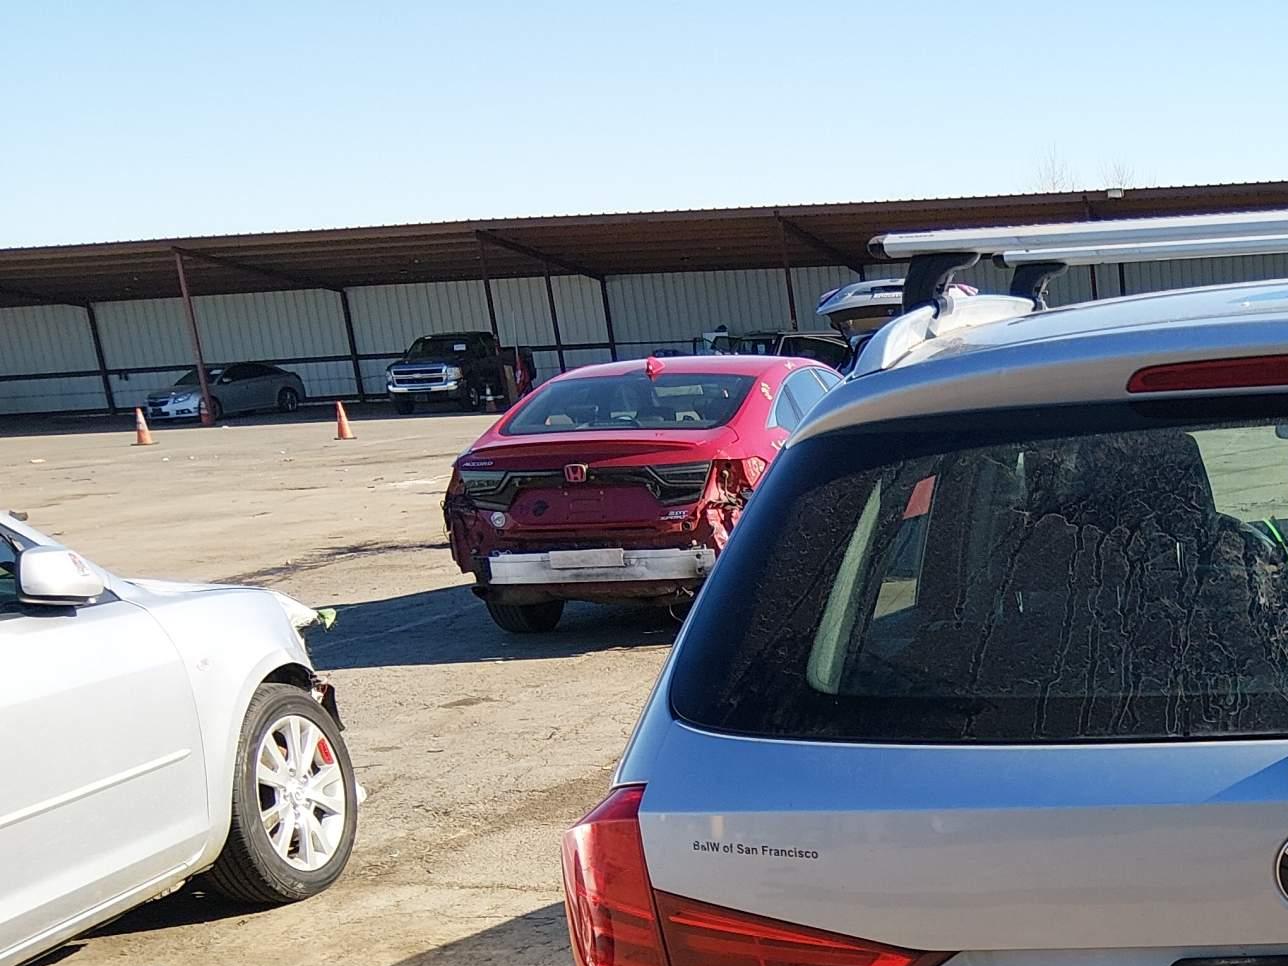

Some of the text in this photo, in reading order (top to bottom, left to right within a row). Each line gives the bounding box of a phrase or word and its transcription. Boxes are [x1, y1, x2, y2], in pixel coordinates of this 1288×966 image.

[722, 843, 733, 854] of
[736, 843, 758, 856] San
[761, 845, 819, 860] Francisco
